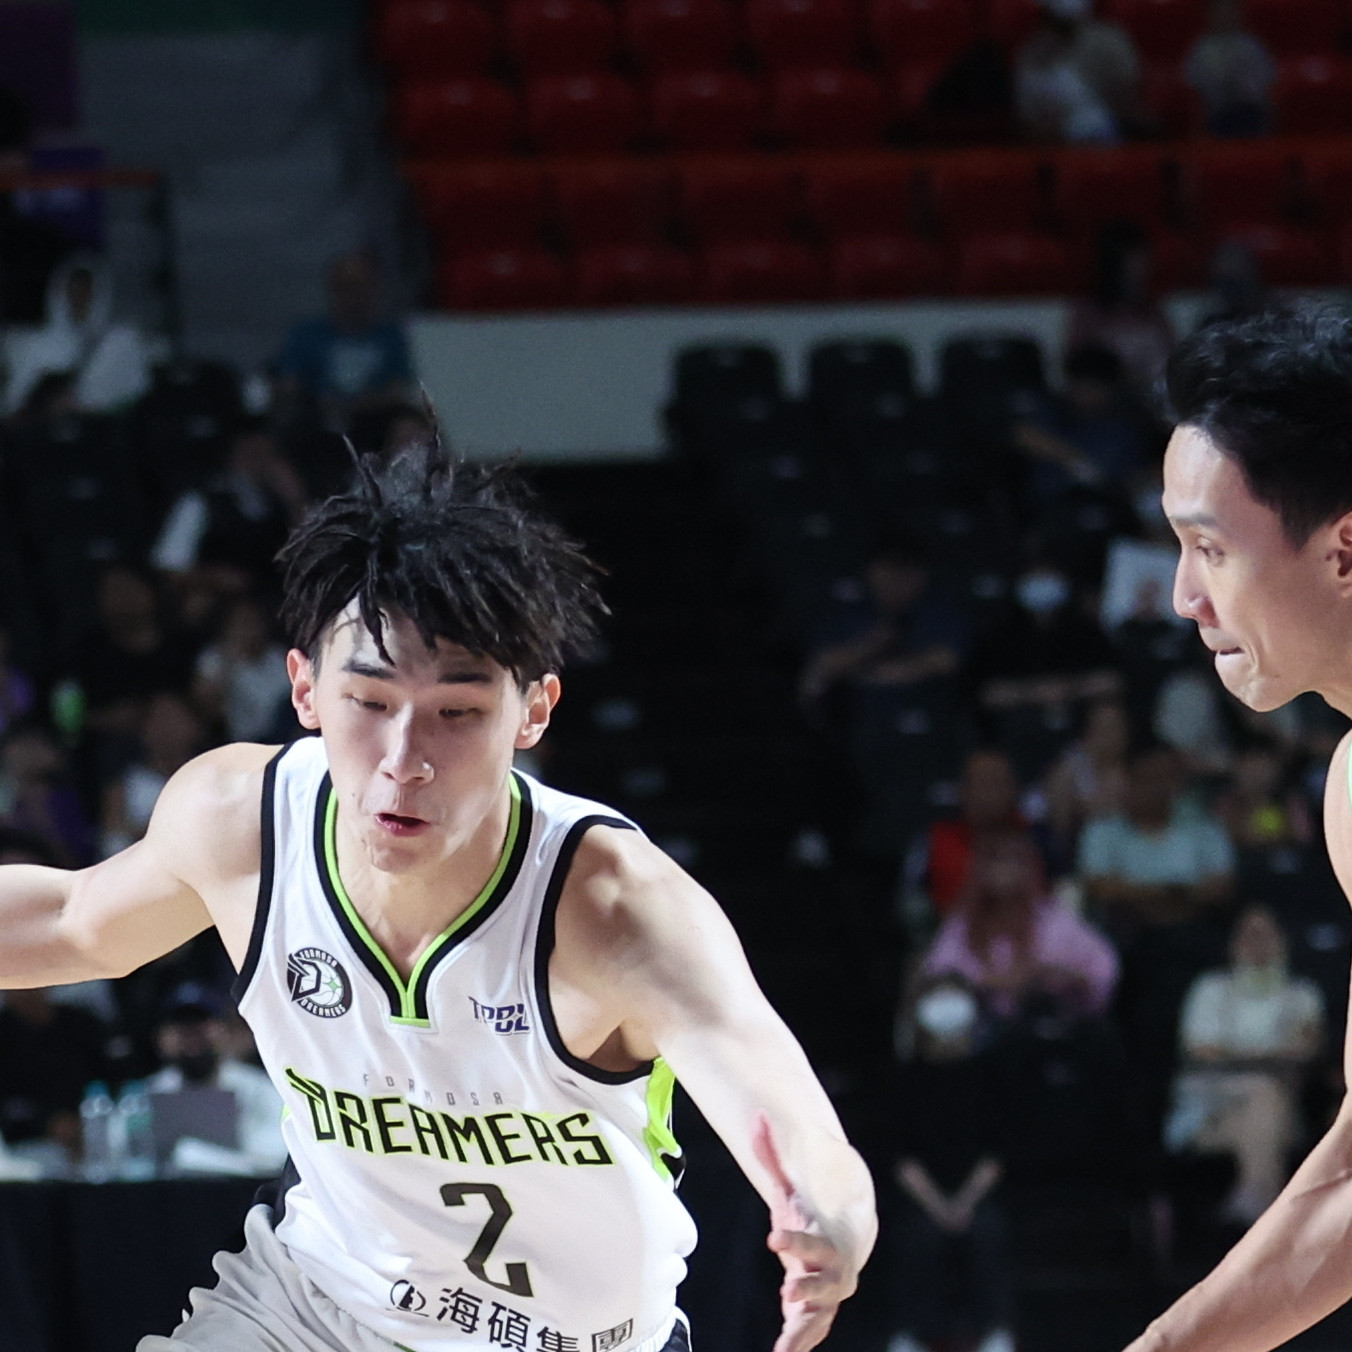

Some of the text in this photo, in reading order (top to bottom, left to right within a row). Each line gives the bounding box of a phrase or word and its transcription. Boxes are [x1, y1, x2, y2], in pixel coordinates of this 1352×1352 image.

[284, 1067, 615, 1166] DREAMERS
[362, 1073, 504, 1107] FORMOSA
[439, 1182, 535, 1298] 2
